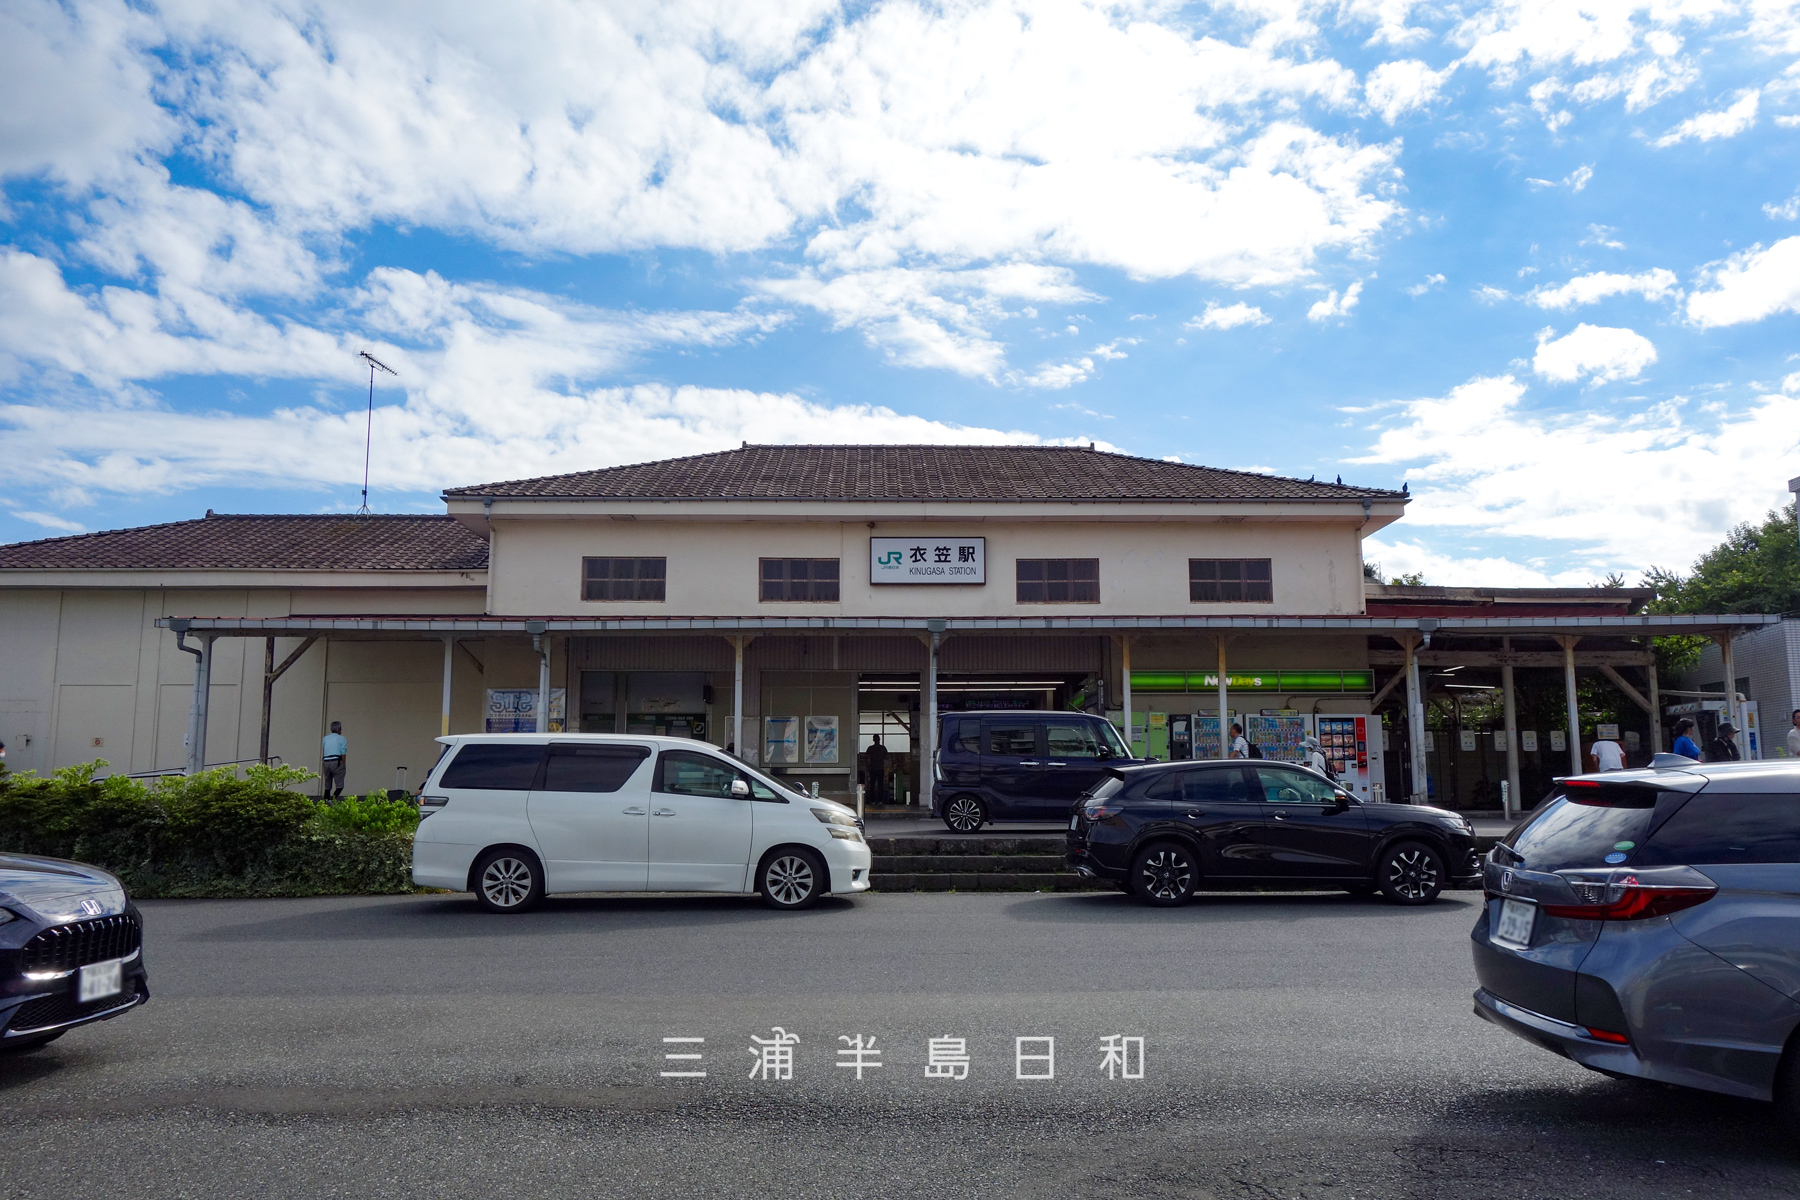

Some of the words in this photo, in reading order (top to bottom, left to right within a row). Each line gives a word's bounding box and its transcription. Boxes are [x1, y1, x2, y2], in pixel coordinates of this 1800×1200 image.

[878, 551, 903, 565] JR
[909, 546, 976, 563] 衣笠駅
[909, 566, 946, 576] KINUGASA
[948, 566, 977, 576] STATION
[490, 690, 533, 713] STS
